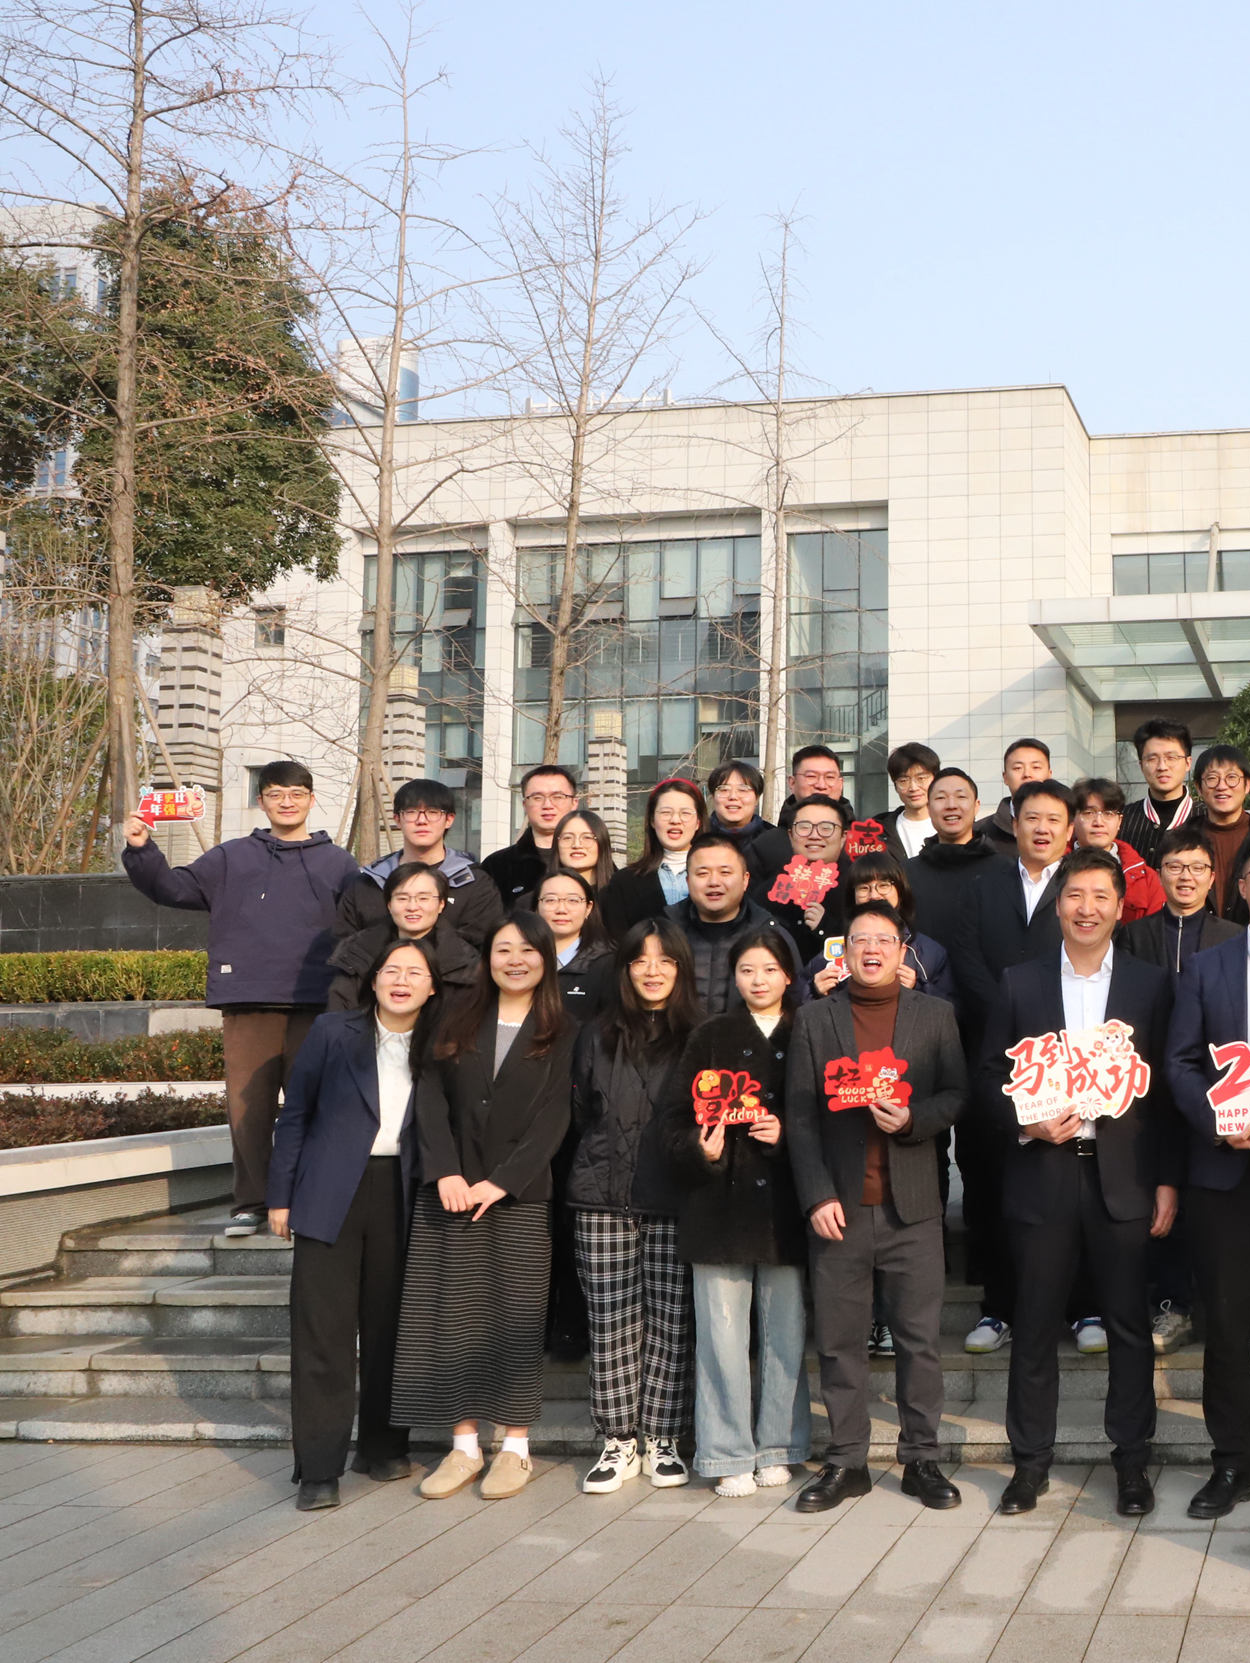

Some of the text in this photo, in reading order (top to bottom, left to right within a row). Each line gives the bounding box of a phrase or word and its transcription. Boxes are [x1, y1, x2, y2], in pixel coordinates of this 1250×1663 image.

[848, 842, 883, 854] Horse
[1004, 1031, 1148, 1116] 马到成功
[838, 1087, 866, 1095] GOOD
[841, 1095, 868, 1103] LUCK
[1018, 1096, 1058, 1111] YEAR OF
[1020, 1112, 1039, 1123] THE
[1218, 1122, 1245, 1132] NEW
